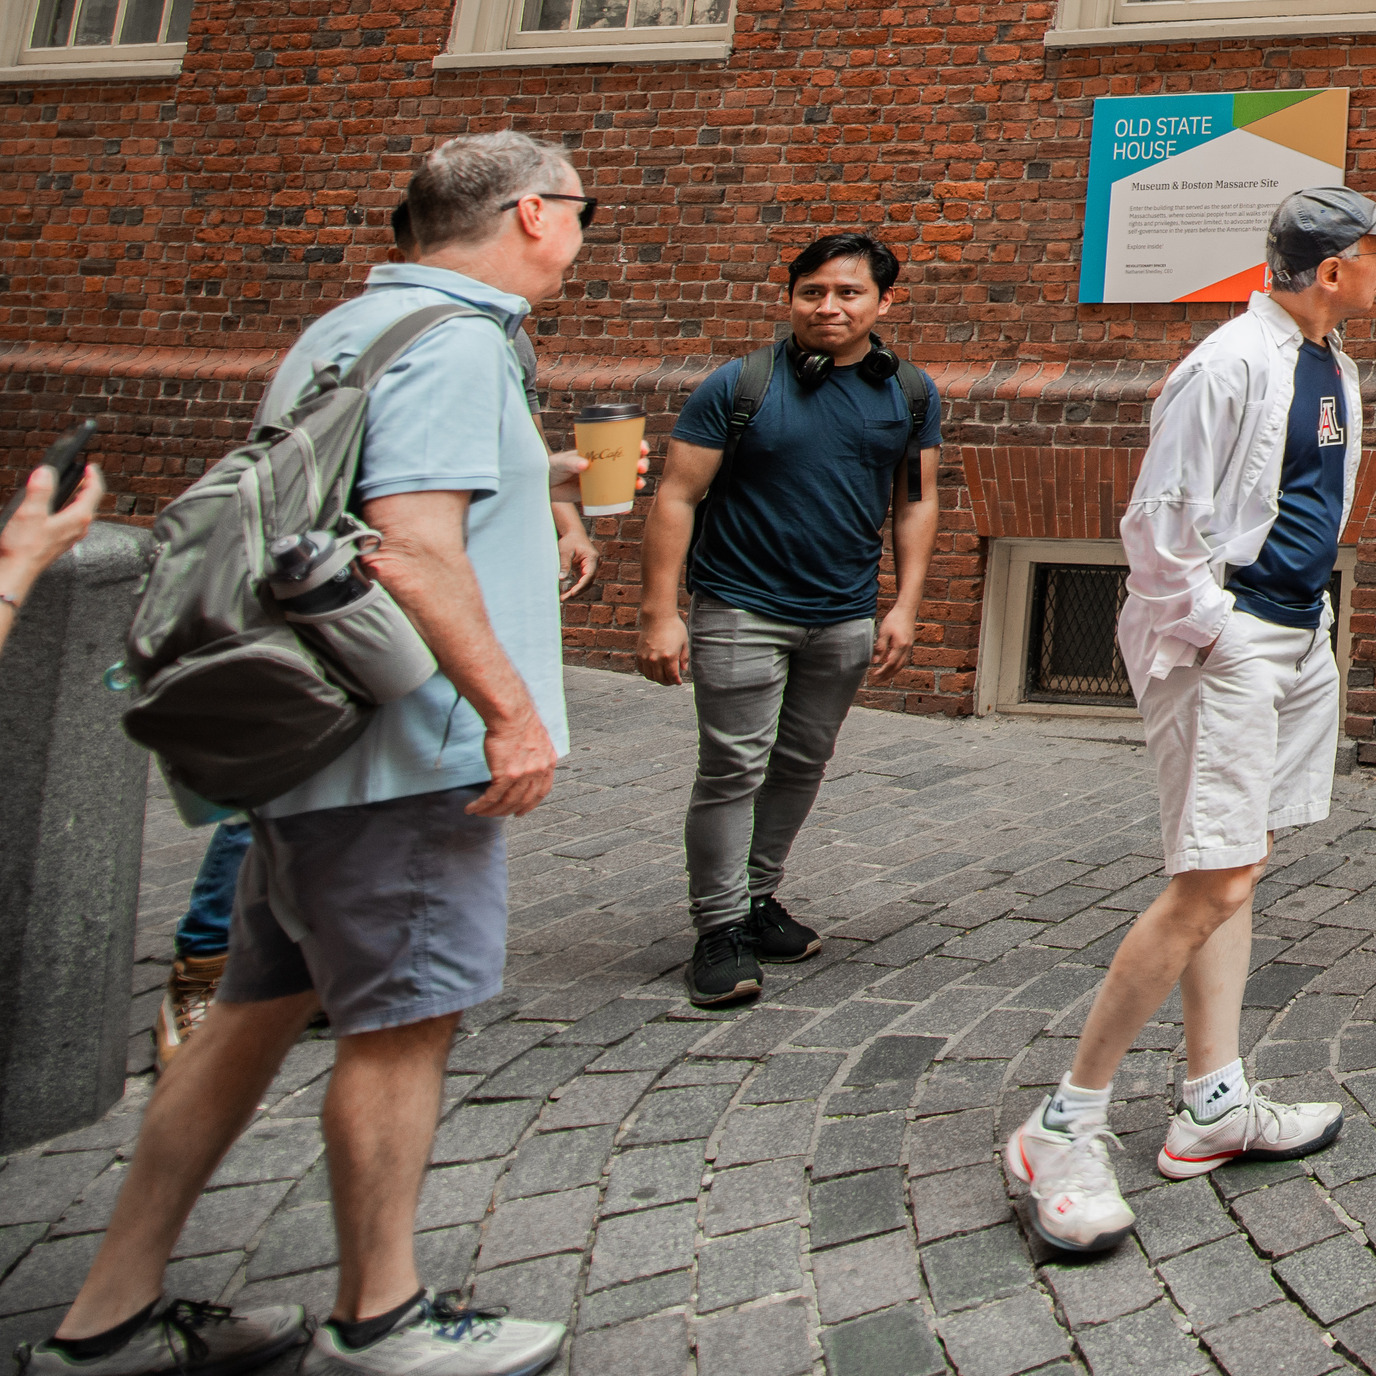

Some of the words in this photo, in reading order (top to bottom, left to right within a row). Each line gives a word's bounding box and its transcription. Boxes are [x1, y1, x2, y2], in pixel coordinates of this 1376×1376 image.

[1115, 118, 1151, 137] OLD
[1156, 116, 1212, 136] STATE
[1113, 140, 1176, 160] HOUSE
[1132, 182, 1170, 191] Museum
[1172, 181, 1179, 190] &
[1182, 180, 1213, 190] Boston
[1215, 180, 1258, 189] Massacre
[1260, 179, 1279, 187] Site
[1318, 396, 1344, 448] A
